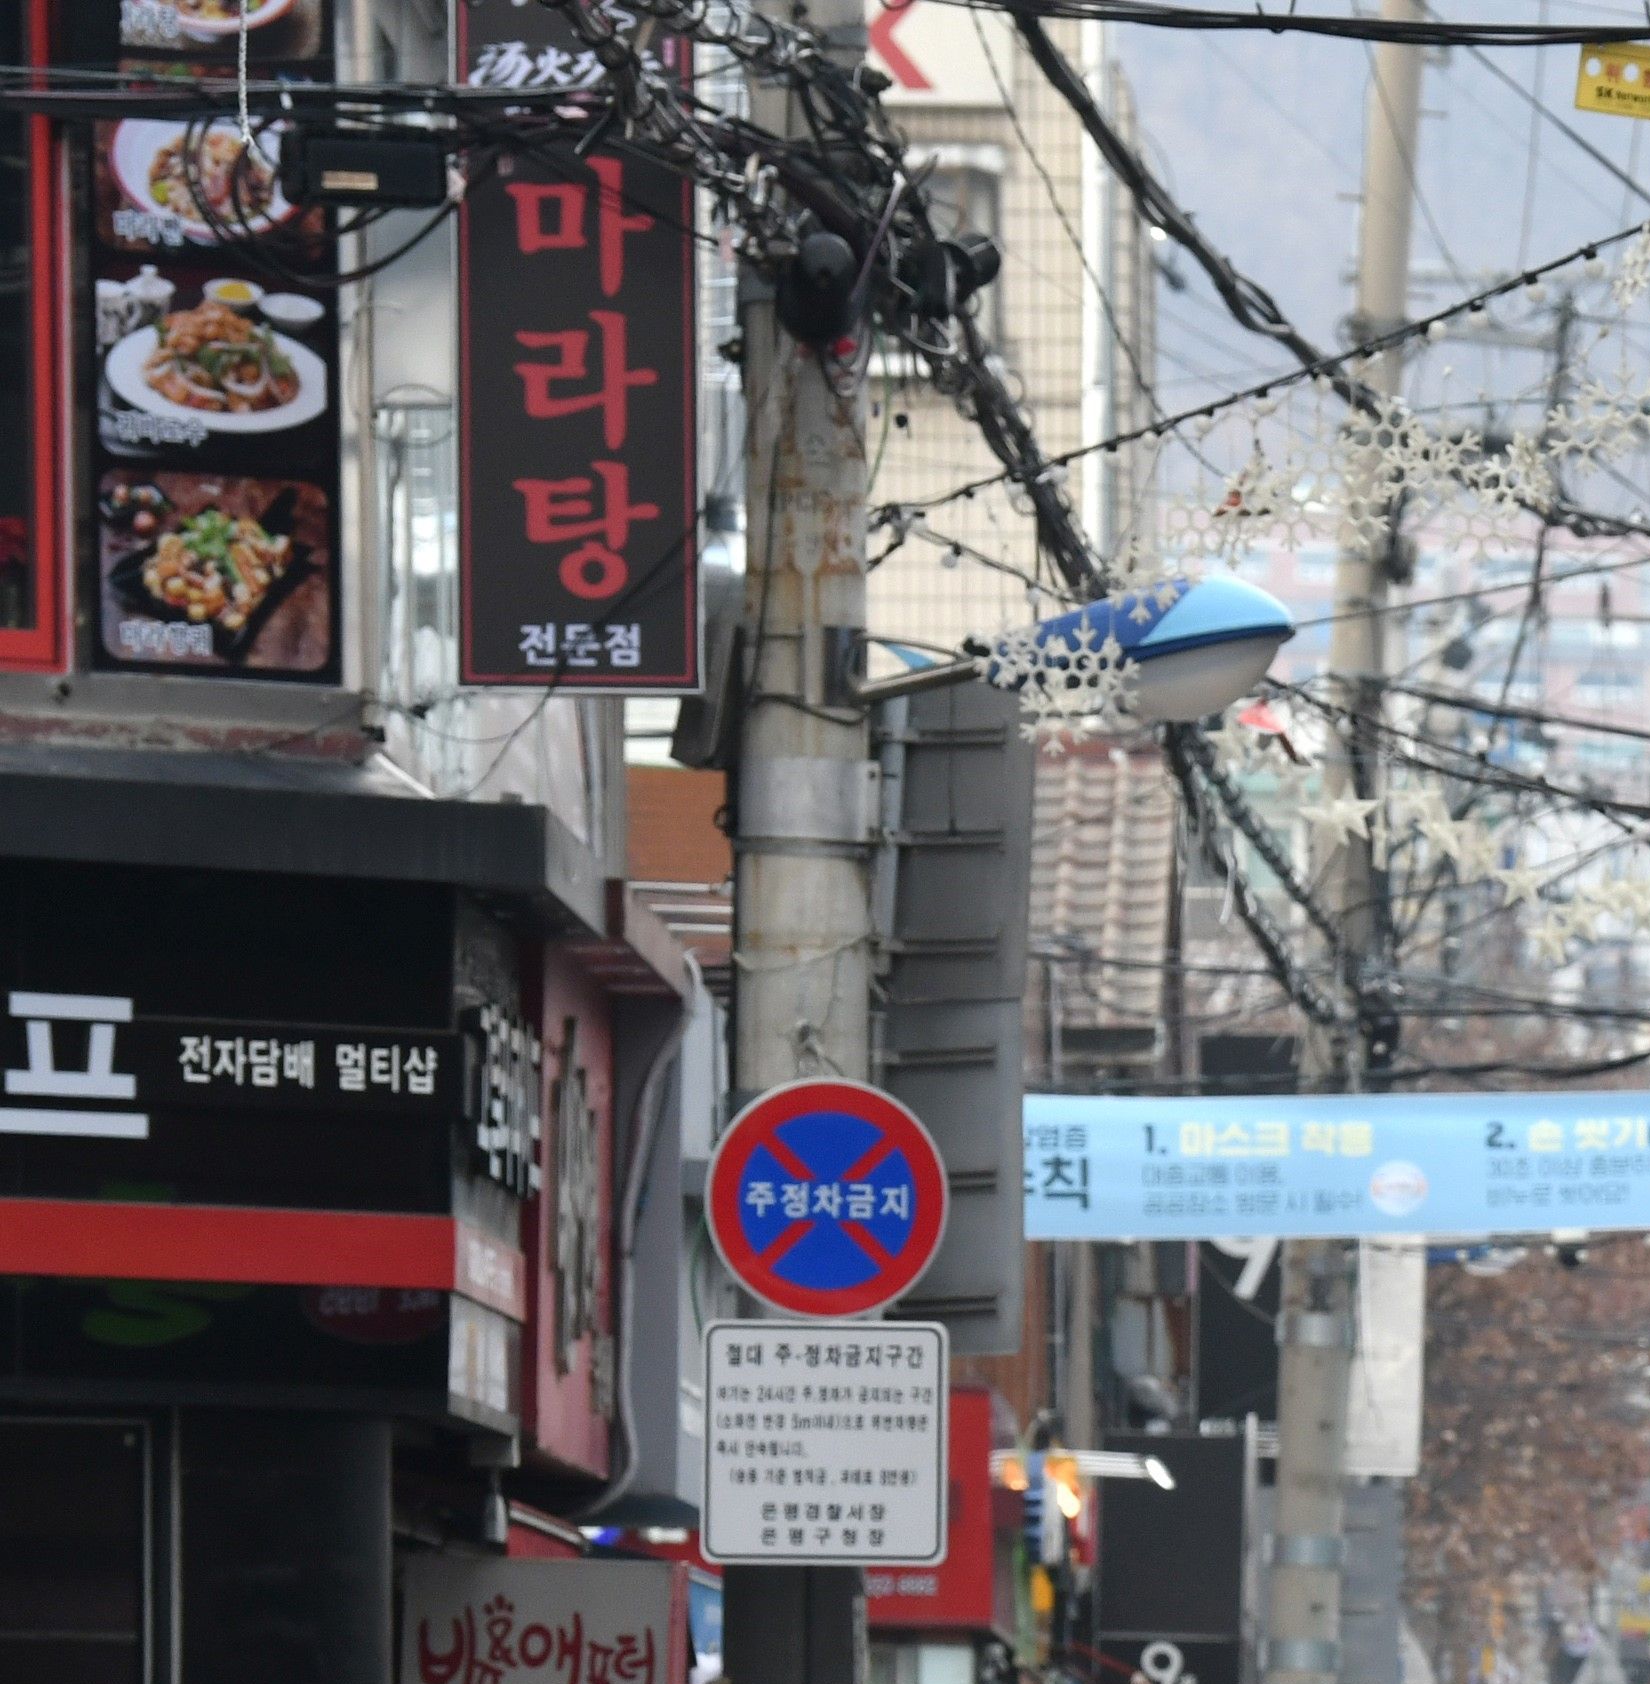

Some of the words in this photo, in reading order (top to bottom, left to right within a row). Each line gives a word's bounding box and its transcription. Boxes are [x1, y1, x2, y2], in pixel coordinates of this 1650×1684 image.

[507, 155, 660, 601] 마라탕
[517, 624, 642, 669] 전문점
[178, 1036, 315, 1090] 전자담배
[335, 1041, 438, 1095] 멀티샵
[745, 1180, 910, 1219] 주정차금지
